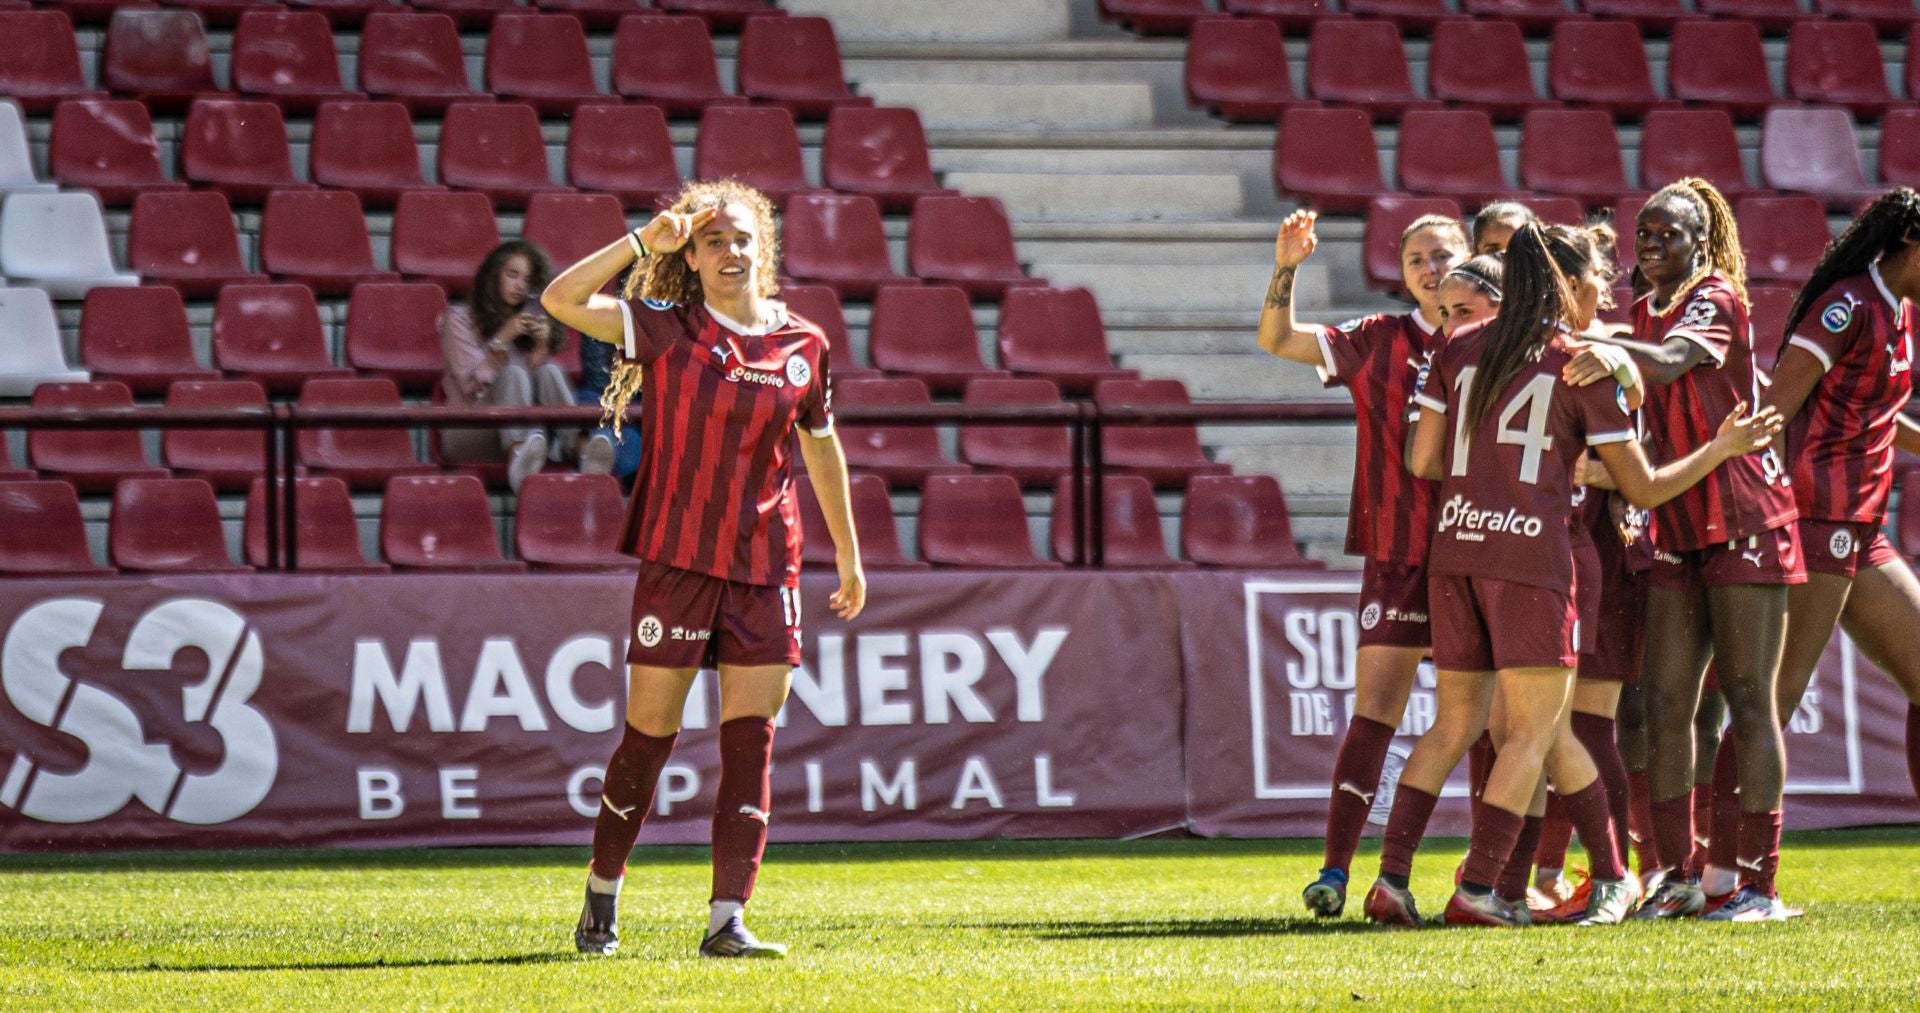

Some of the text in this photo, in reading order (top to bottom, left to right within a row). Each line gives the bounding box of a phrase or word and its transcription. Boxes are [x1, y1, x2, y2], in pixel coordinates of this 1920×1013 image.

[730, 367, 785, 388] LOGROÑO
[1451, 366, 1556, 485] 14
[685, 629, 697, 641] La
[1398, 611, 1428, 624] La Rioja
[347, 627, 1070, 733] MACNERY
[1289, 692, 1335, 736] DE
[358, 756, 1075, 819] BE OPIMAL
